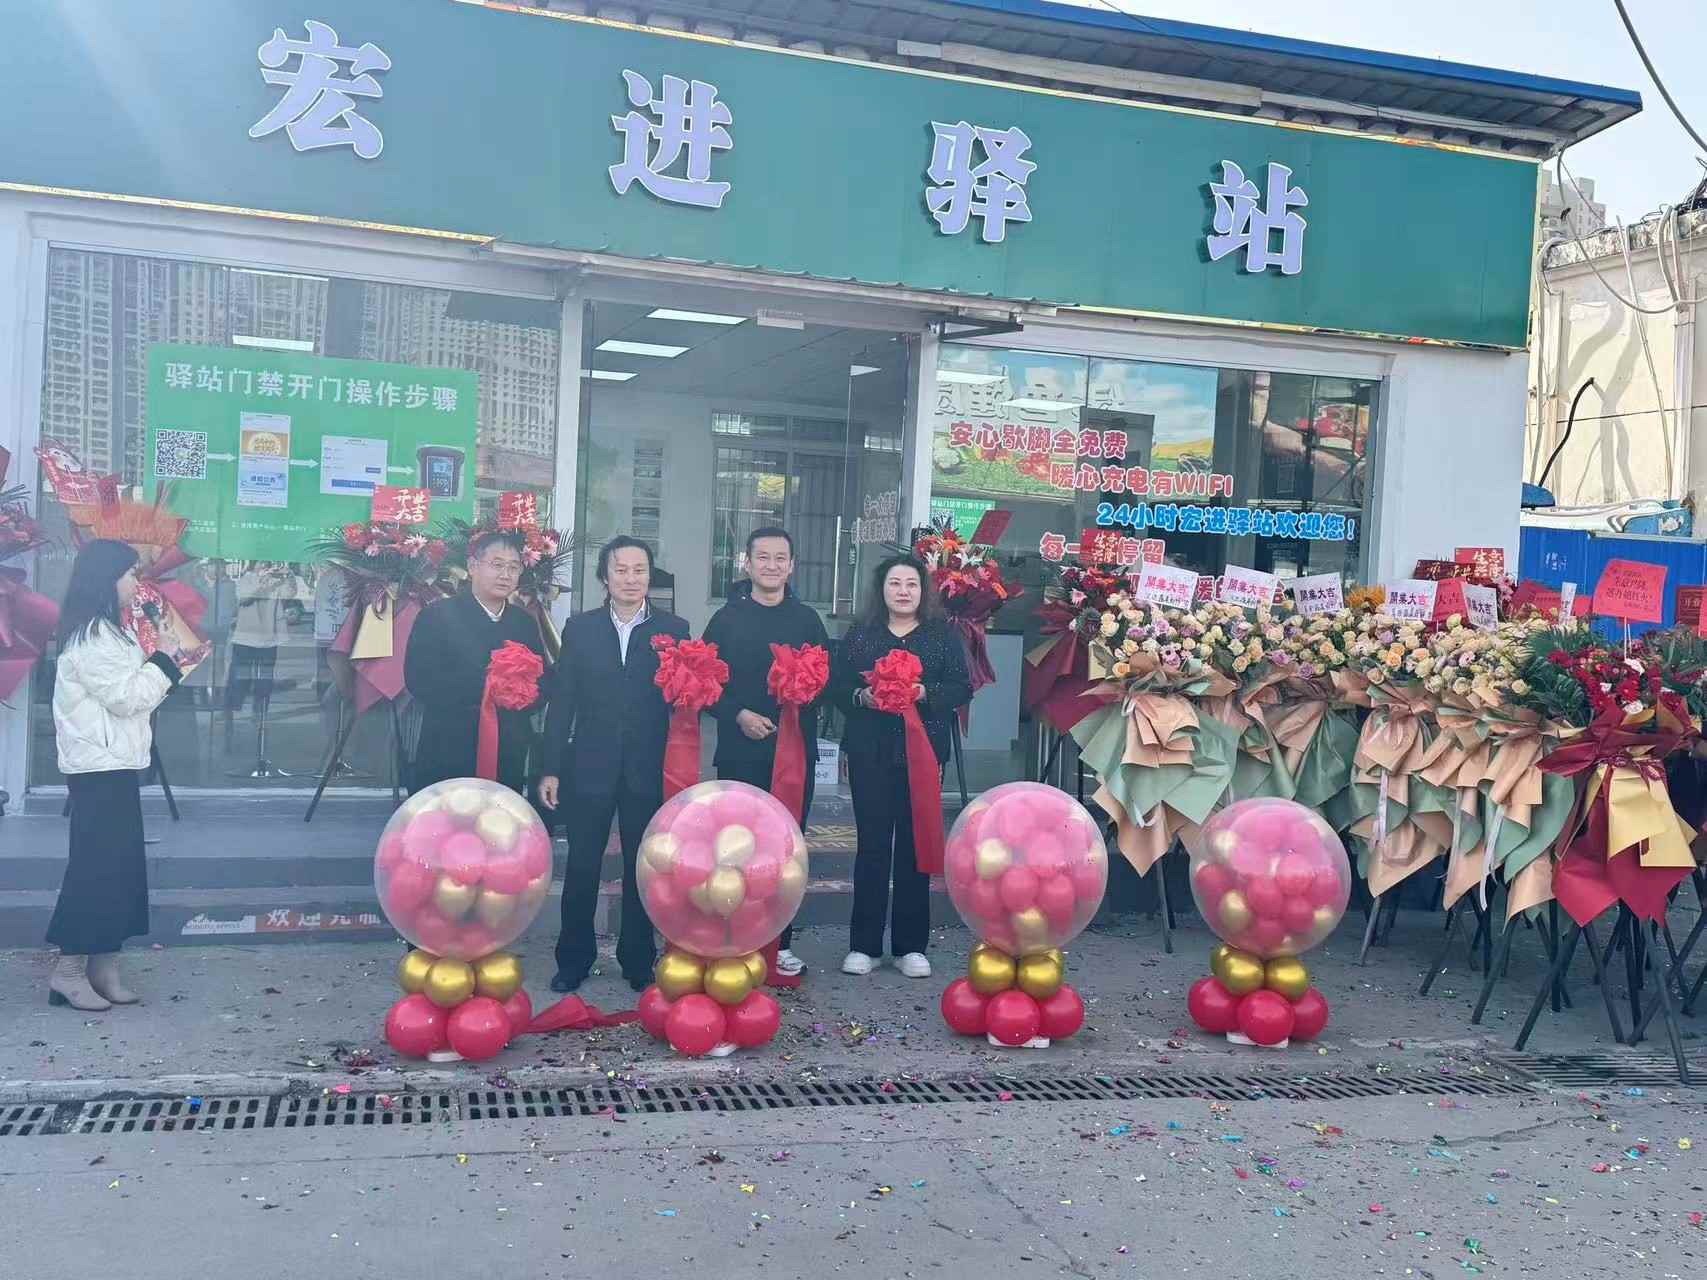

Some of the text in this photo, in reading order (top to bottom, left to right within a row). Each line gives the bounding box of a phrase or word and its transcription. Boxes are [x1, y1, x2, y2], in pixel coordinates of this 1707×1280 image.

[248, 19, 1309, 275] 宏进驿站
[164, 361, 459, 412] 驿站门禁开门操作步骤
[950, 420, 1127, 460] 安心歇脚全免费
[1050, 462, 1234, 498] 暖心充电有WIFI
[1096, 502, 1356, 540] 24小时宏进驿站欢迎您!
[1039, 532, 1166, 566] 每一停留
